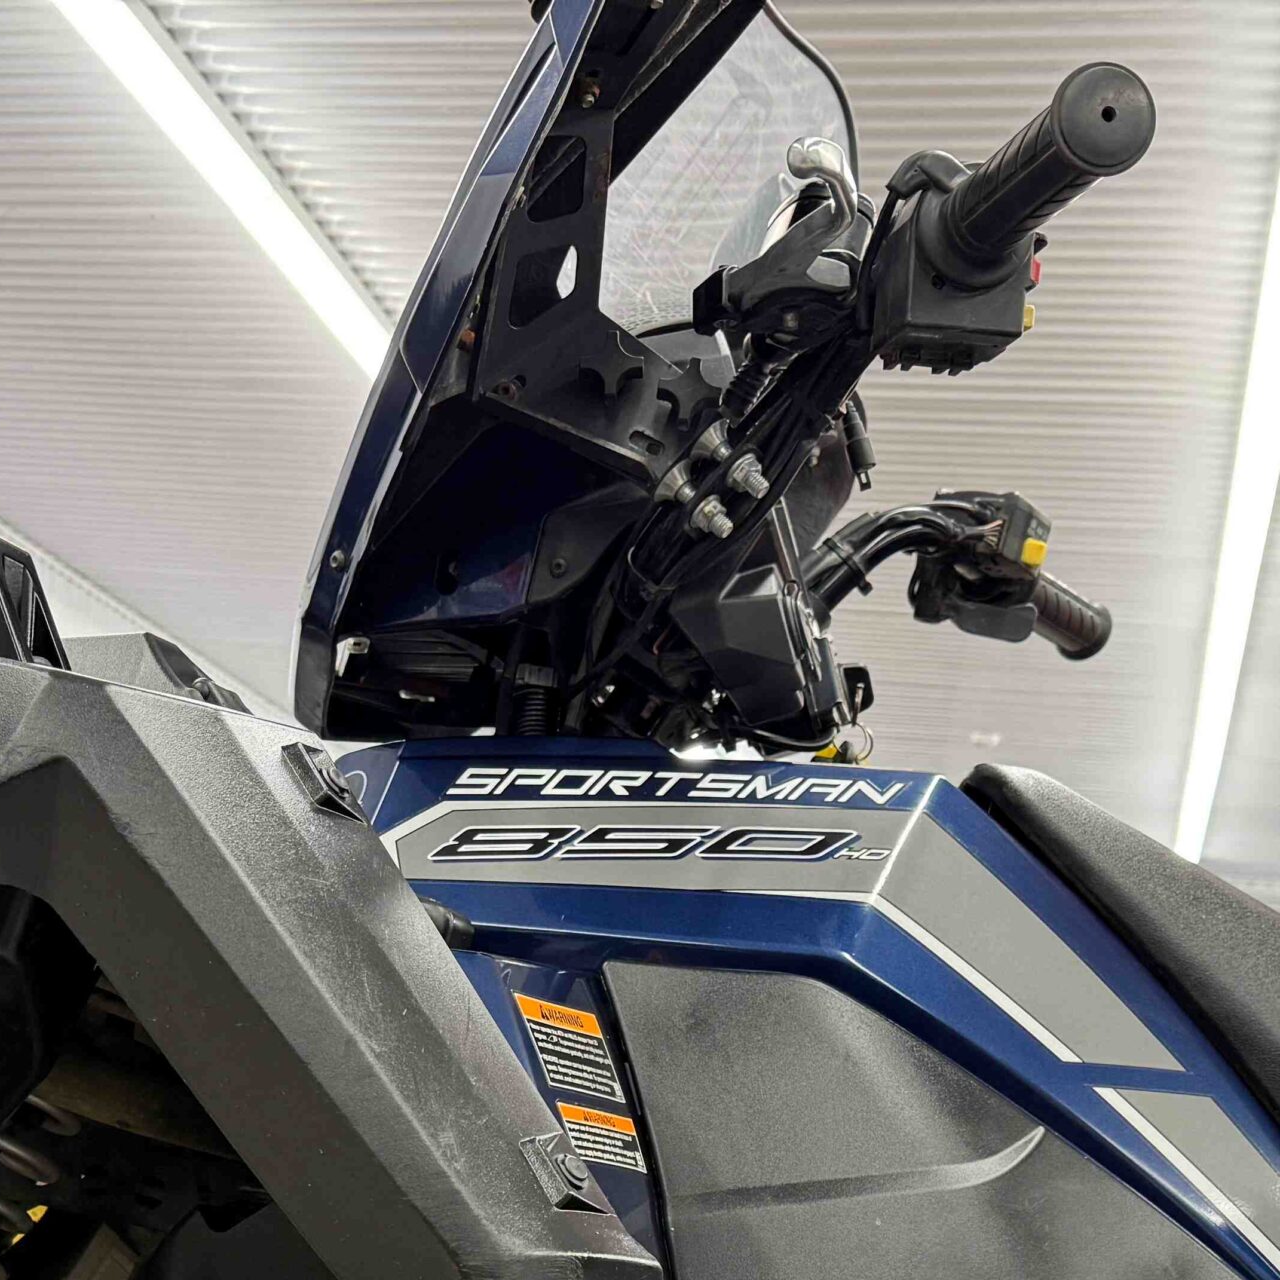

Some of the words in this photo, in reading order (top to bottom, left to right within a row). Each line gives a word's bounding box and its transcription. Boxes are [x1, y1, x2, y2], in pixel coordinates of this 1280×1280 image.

[446, 767, 905, 805] SPORTSMAN
[428, 824, 859, 863] 850
[547, 1007, 584, 1028] WARNING
